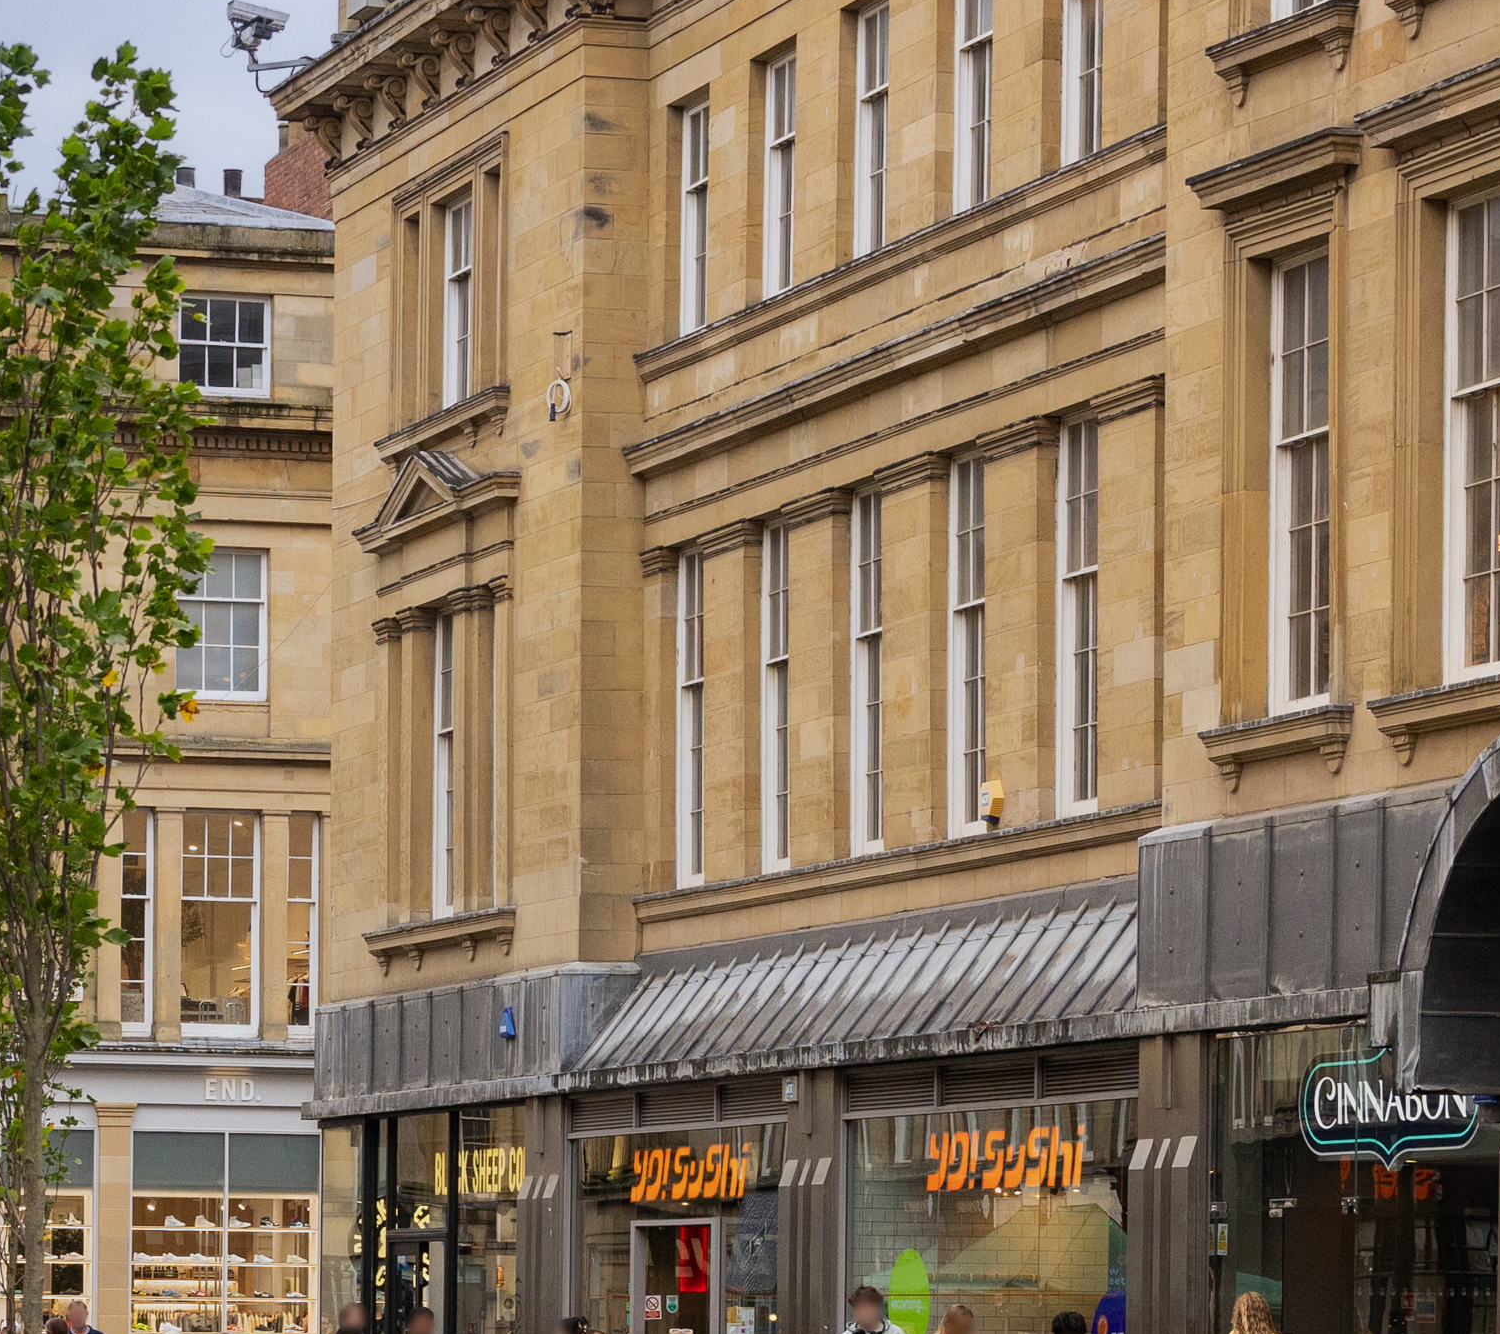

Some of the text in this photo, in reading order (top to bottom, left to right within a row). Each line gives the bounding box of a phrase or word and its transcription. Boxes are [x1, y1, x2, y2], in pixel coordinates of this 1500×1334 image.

[204, 1078, 262, 1103] END.
[1313, 1076, 1469, 1130] CINNABON
[472, 1147, 506, 1194] SHEEP
